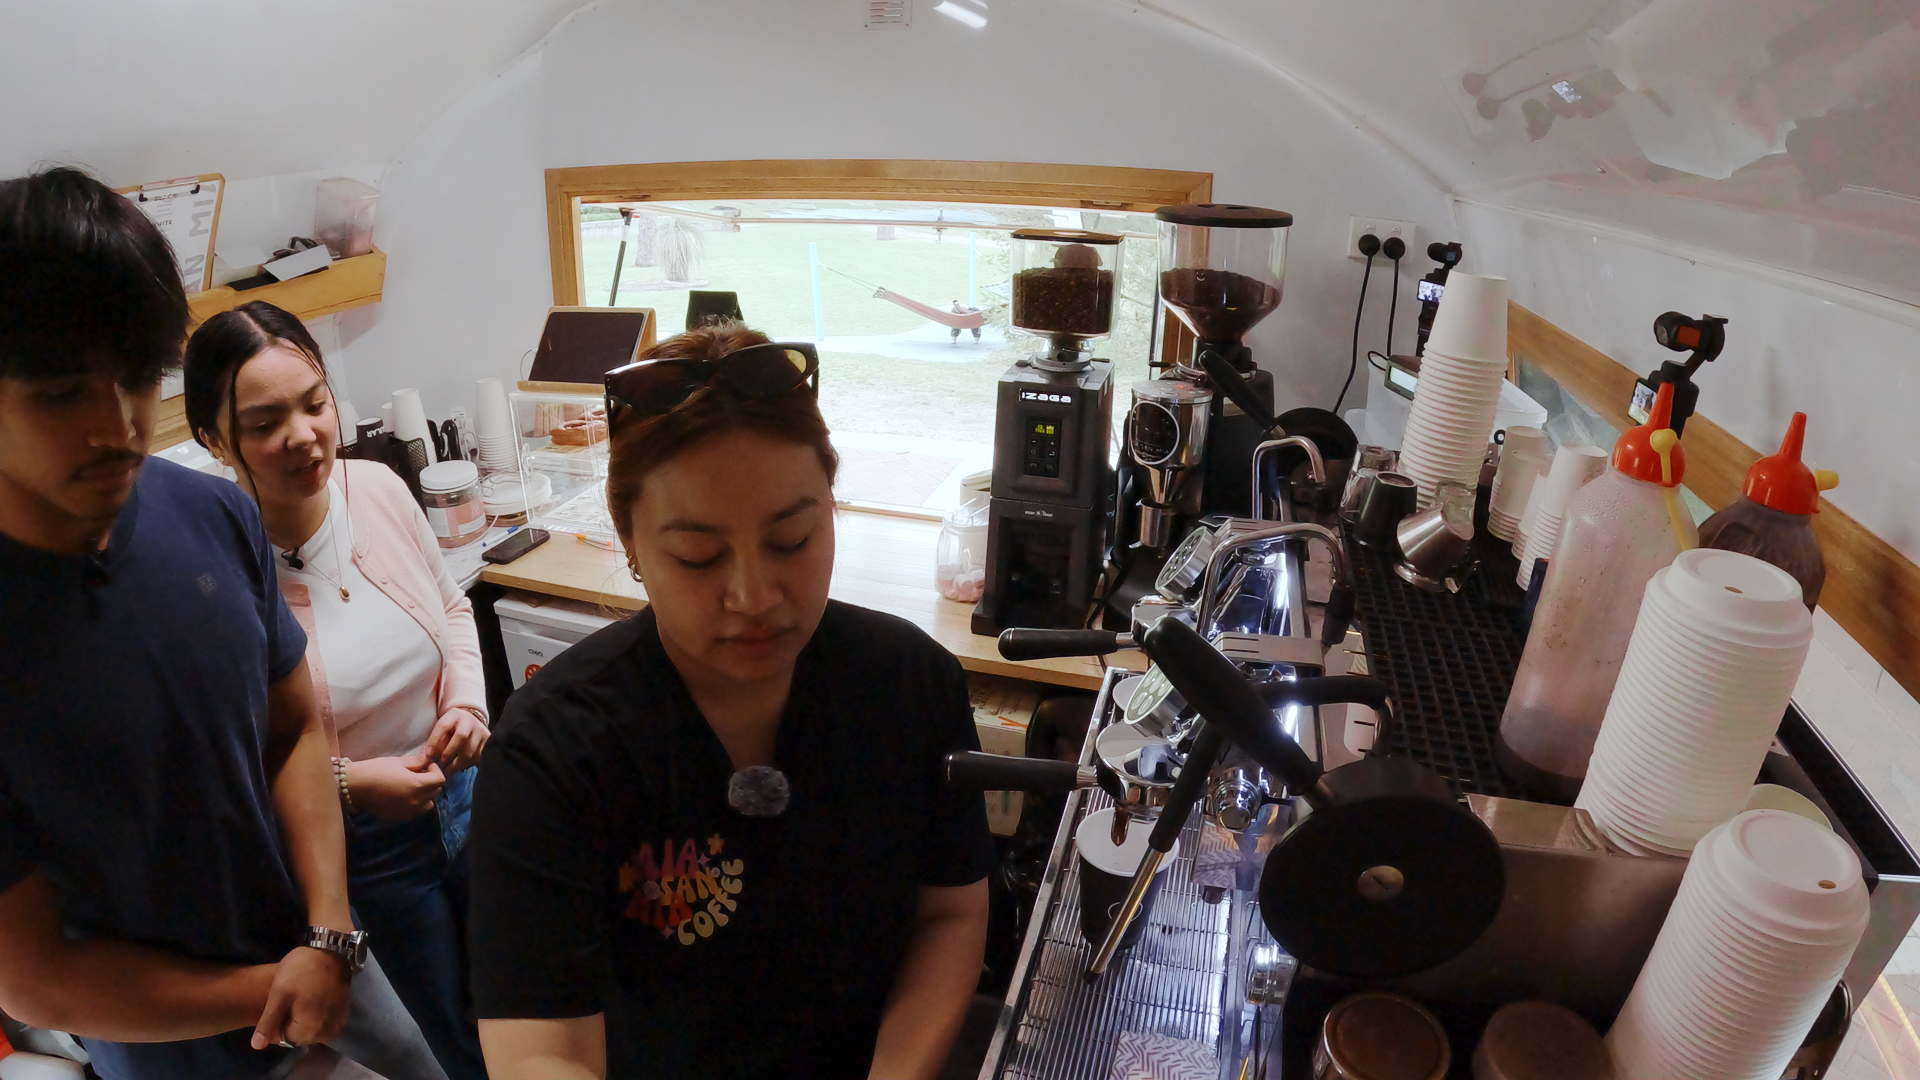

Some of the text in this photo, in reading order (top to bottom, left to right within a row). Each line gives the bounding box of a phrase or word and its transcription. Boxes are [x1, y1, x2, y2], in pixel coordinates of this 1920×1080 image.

[156, 219, 173, 227] HITE
[660, 866, 719, 906] SAN
[677, 858, 744, 946] COFFEE
